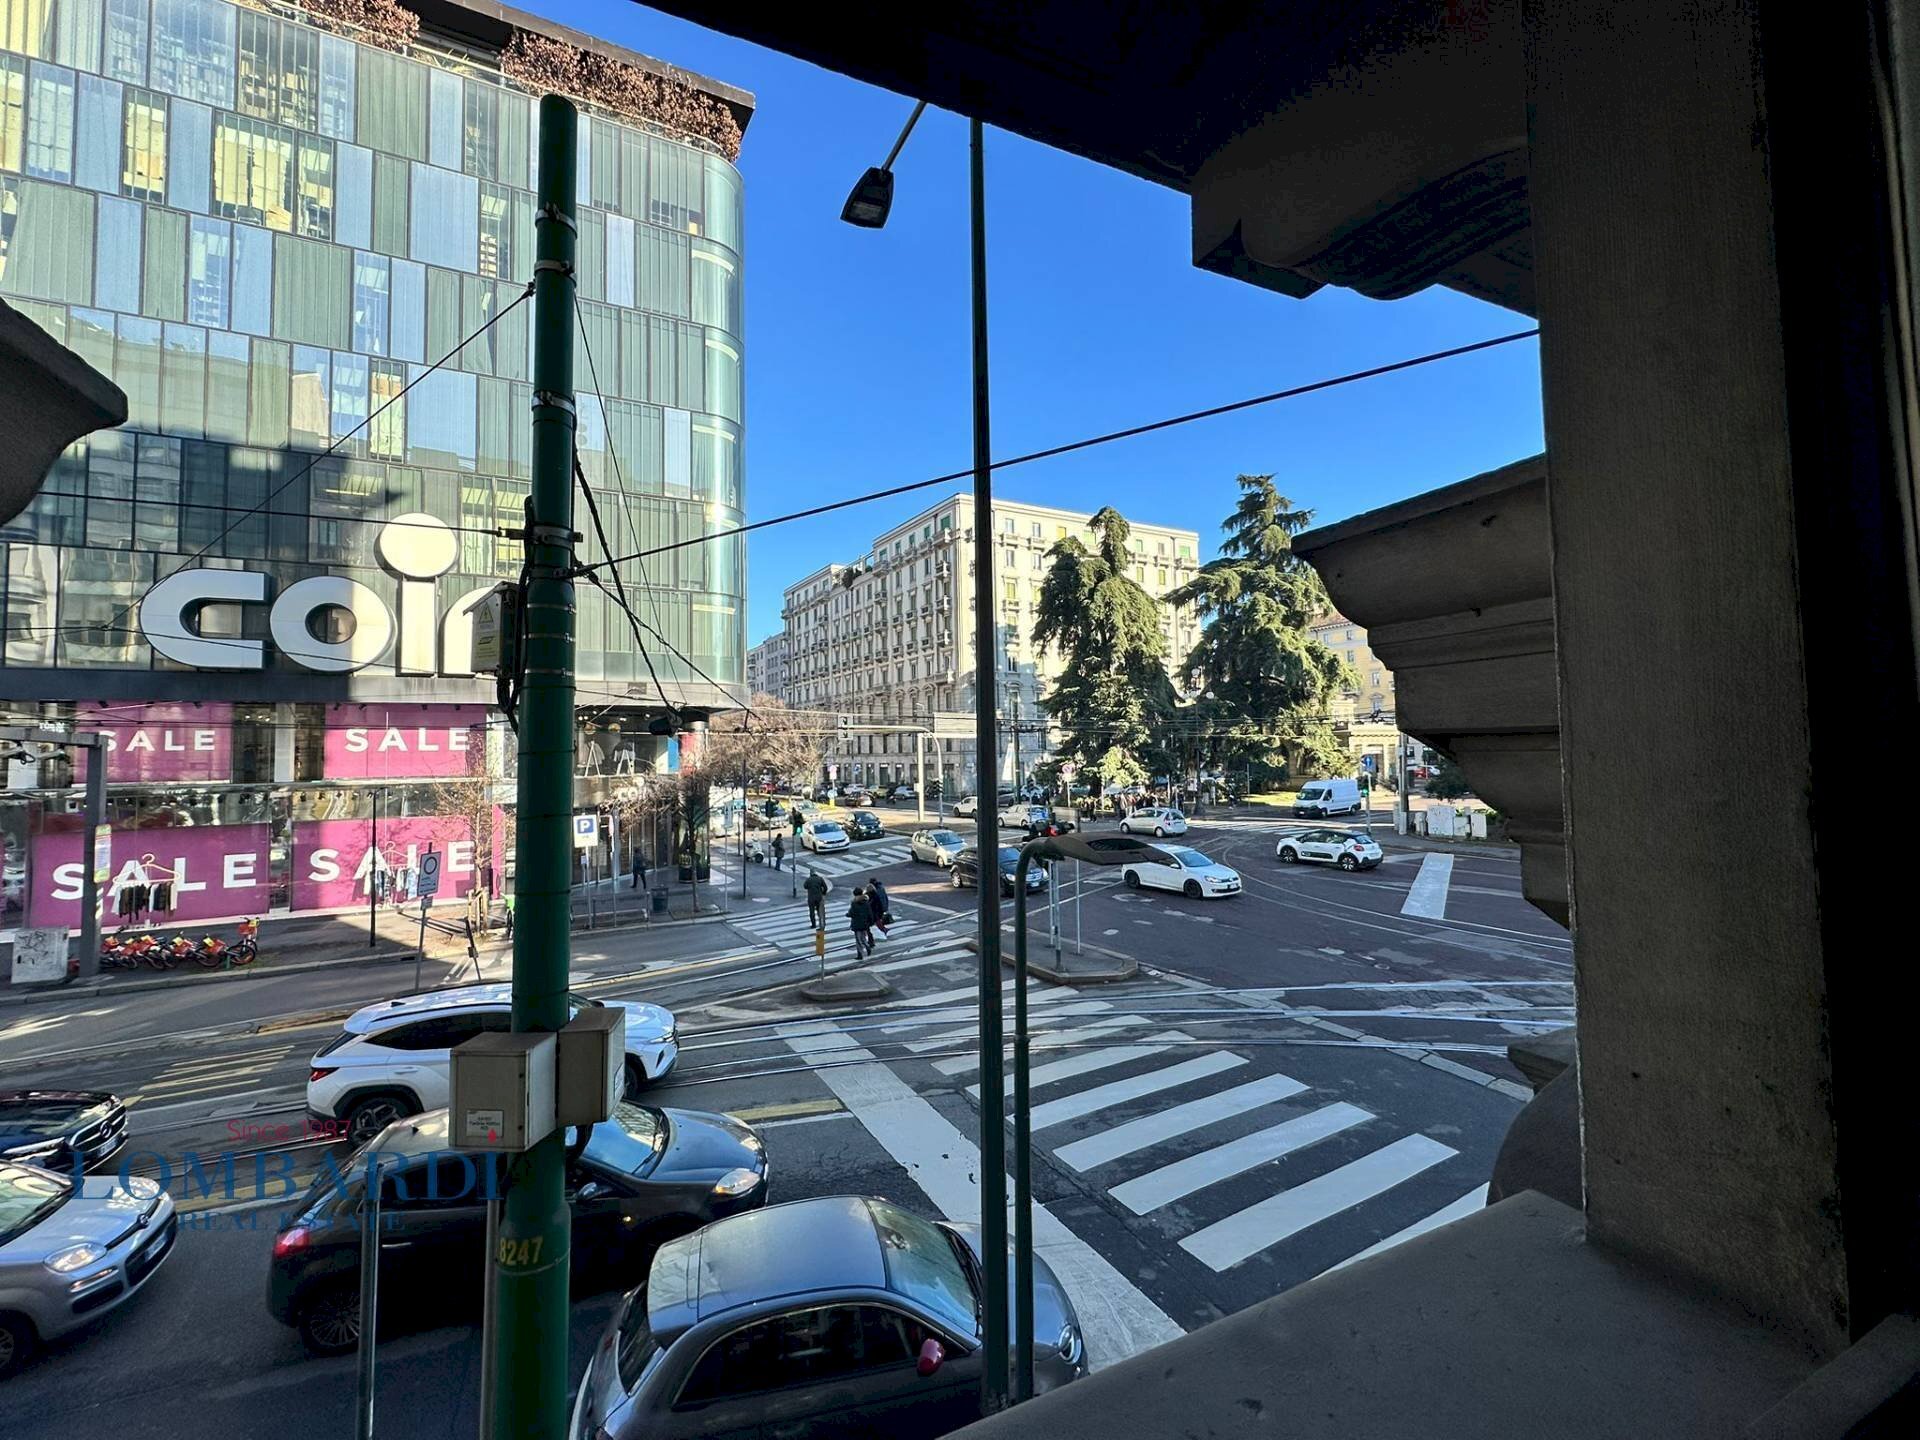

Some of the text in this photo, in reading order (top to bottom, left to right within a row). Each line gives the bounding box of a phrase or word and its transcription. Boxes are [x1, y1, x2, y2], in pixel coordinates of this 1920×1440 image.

[98, 730, 216, 752] SALE
[344, 728, 471, 752] SALE
[580, 820, 590, 832] P
[51, 853, 257, 900] SALE
[499, 1236, 543, 1266] 8247
